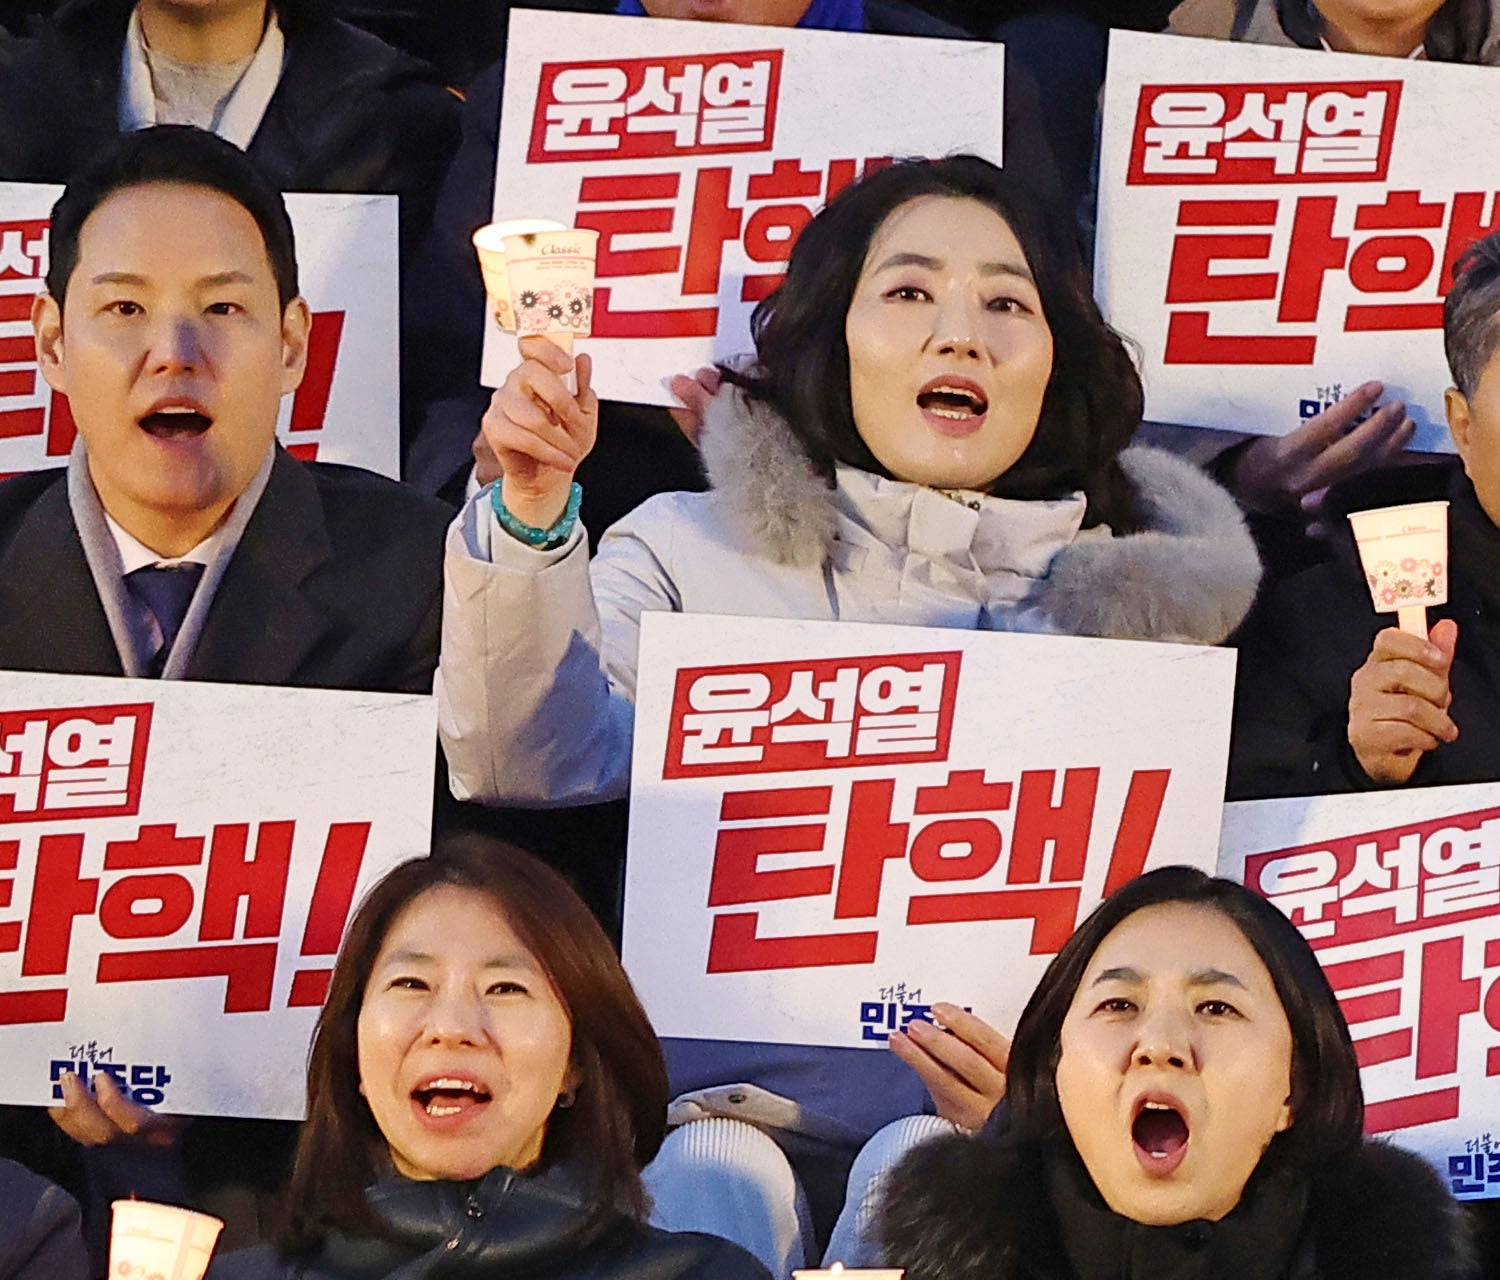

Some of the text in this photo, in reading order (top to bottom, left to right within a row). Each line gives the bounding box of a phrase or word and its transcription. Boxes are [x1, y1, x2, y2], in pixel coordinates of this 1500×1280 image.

[545, 61, 766, 152] 윤석열
[1138, 90, 1391, 175] 윤석열
[682, 662, 943, 764] 윤석열
[707, 768, 1170, 973] 탄핵!
